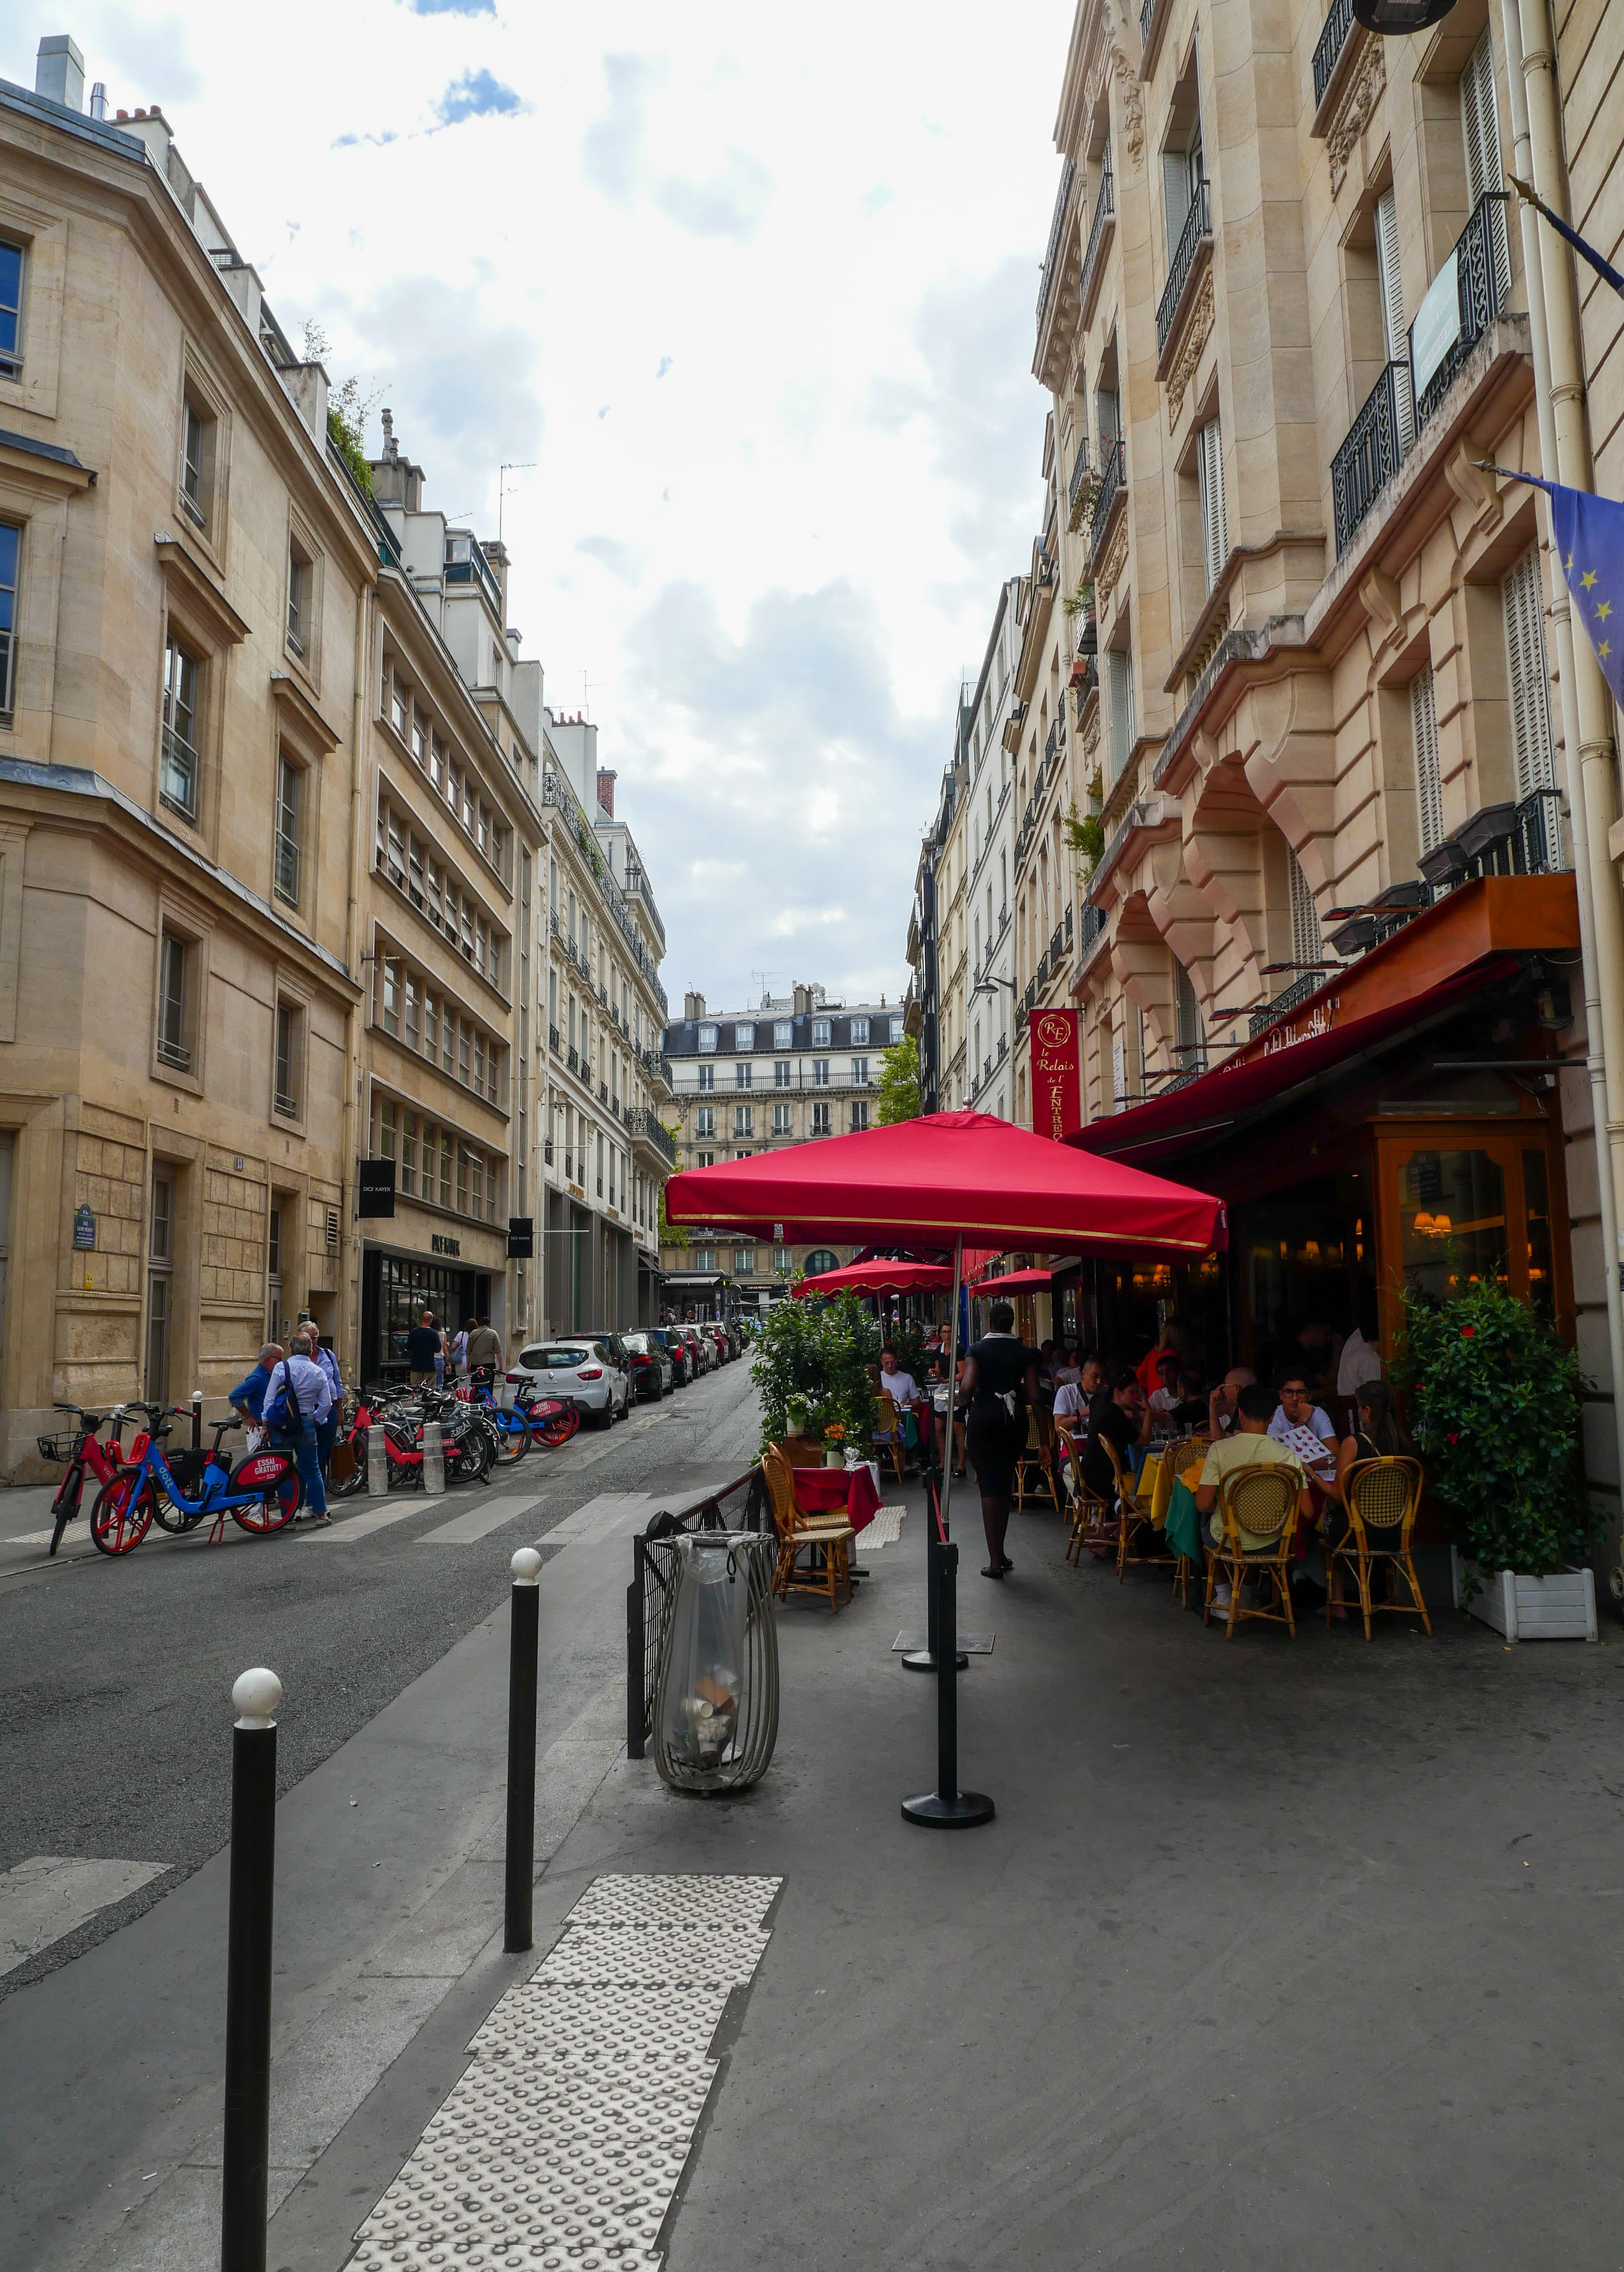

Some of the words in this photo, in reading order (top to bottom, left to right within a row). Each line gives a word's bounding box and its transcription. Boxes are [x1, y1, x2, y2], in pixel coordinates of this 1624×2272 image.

[1041, 1048, 1049, 1056] le
[1036, 1058, 1074, 1071] Relais
[238, 1157, 242, 1169] 13
[258, 1458, 275, 1467] ESSAI
[159, 1467, 174, 1489] dott
